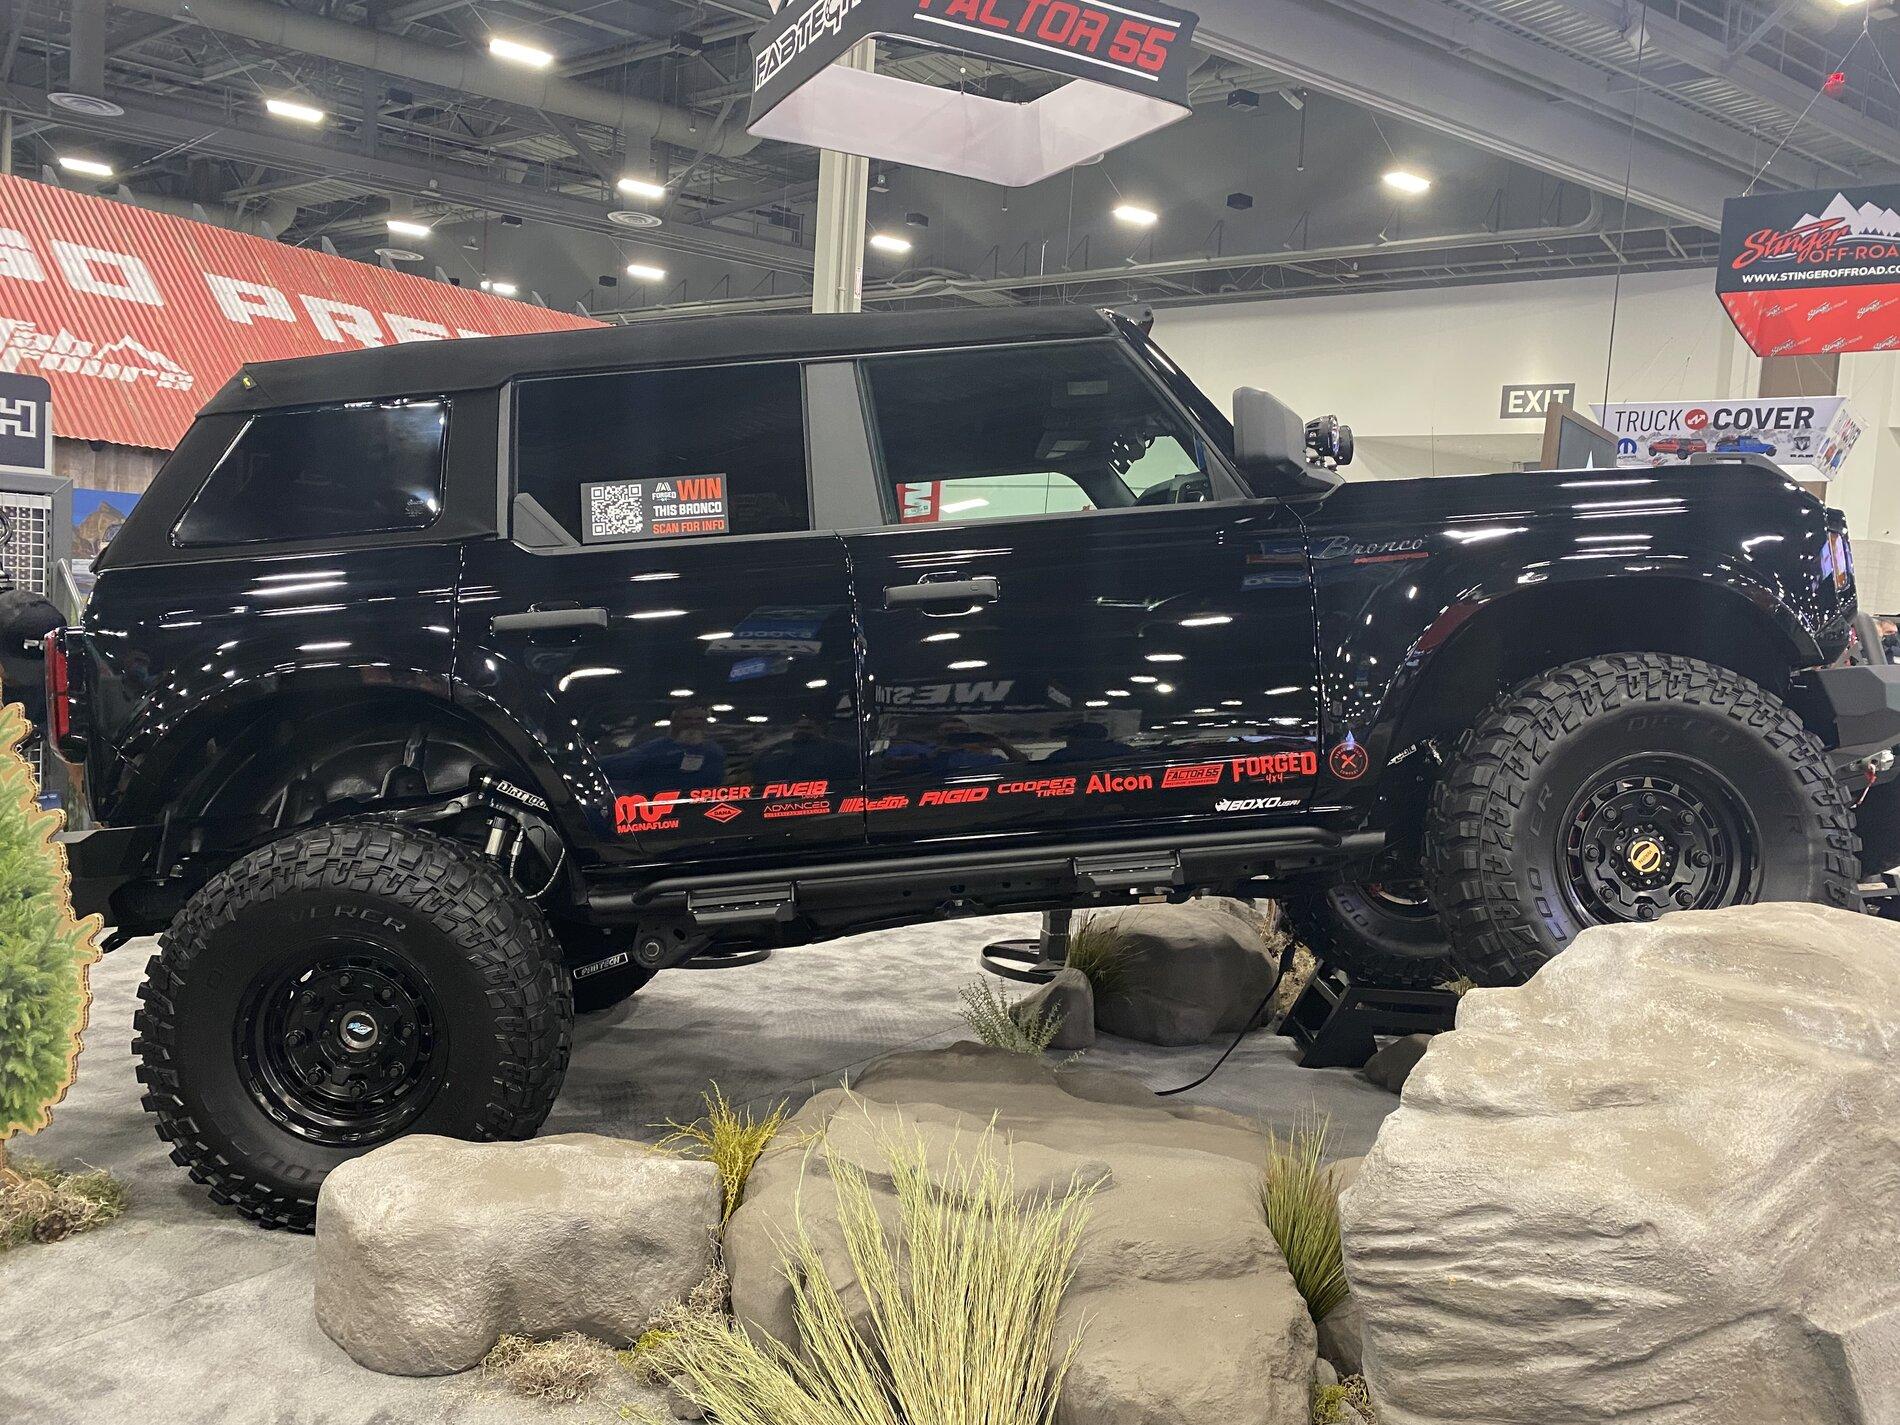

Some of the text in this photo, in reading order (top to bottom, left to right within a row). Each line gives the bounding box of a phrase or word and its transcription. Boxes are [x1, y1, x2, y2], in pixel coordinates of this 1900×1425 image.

[919, 0, 1177, 71] ACTOR 55
[1731, 216, 1851, 270] Stinger
[1508, 390, 1570, 413] EXIT
[1615, 407, 1814, 432] TRUCK COVER
[677, 477, 722, 501] WIN
[653, 502, 722, 517] THIS BRONCO
[653, 519, 725, 534] SCAN FOR INFO
[1313, 536, 1424, 559] Bronco
[1166, 769, 1205, 780] FACTOR
[1232, 751, 1317, 783] FORGED
[997, 777, 1076, 794] COOPER
[1086, 773, 1152, 794] Alcon
[1265, 772, 1284, 783] 4x4
[690, 786, 751, 802] SPICER
[918, 787, 989, 807] RIGID
[1035, 788, 1074, 798] TIRES
[763, 801, 830, 813] ADVANCED
[617, 820, 679, 833] MAGNAFLOW
